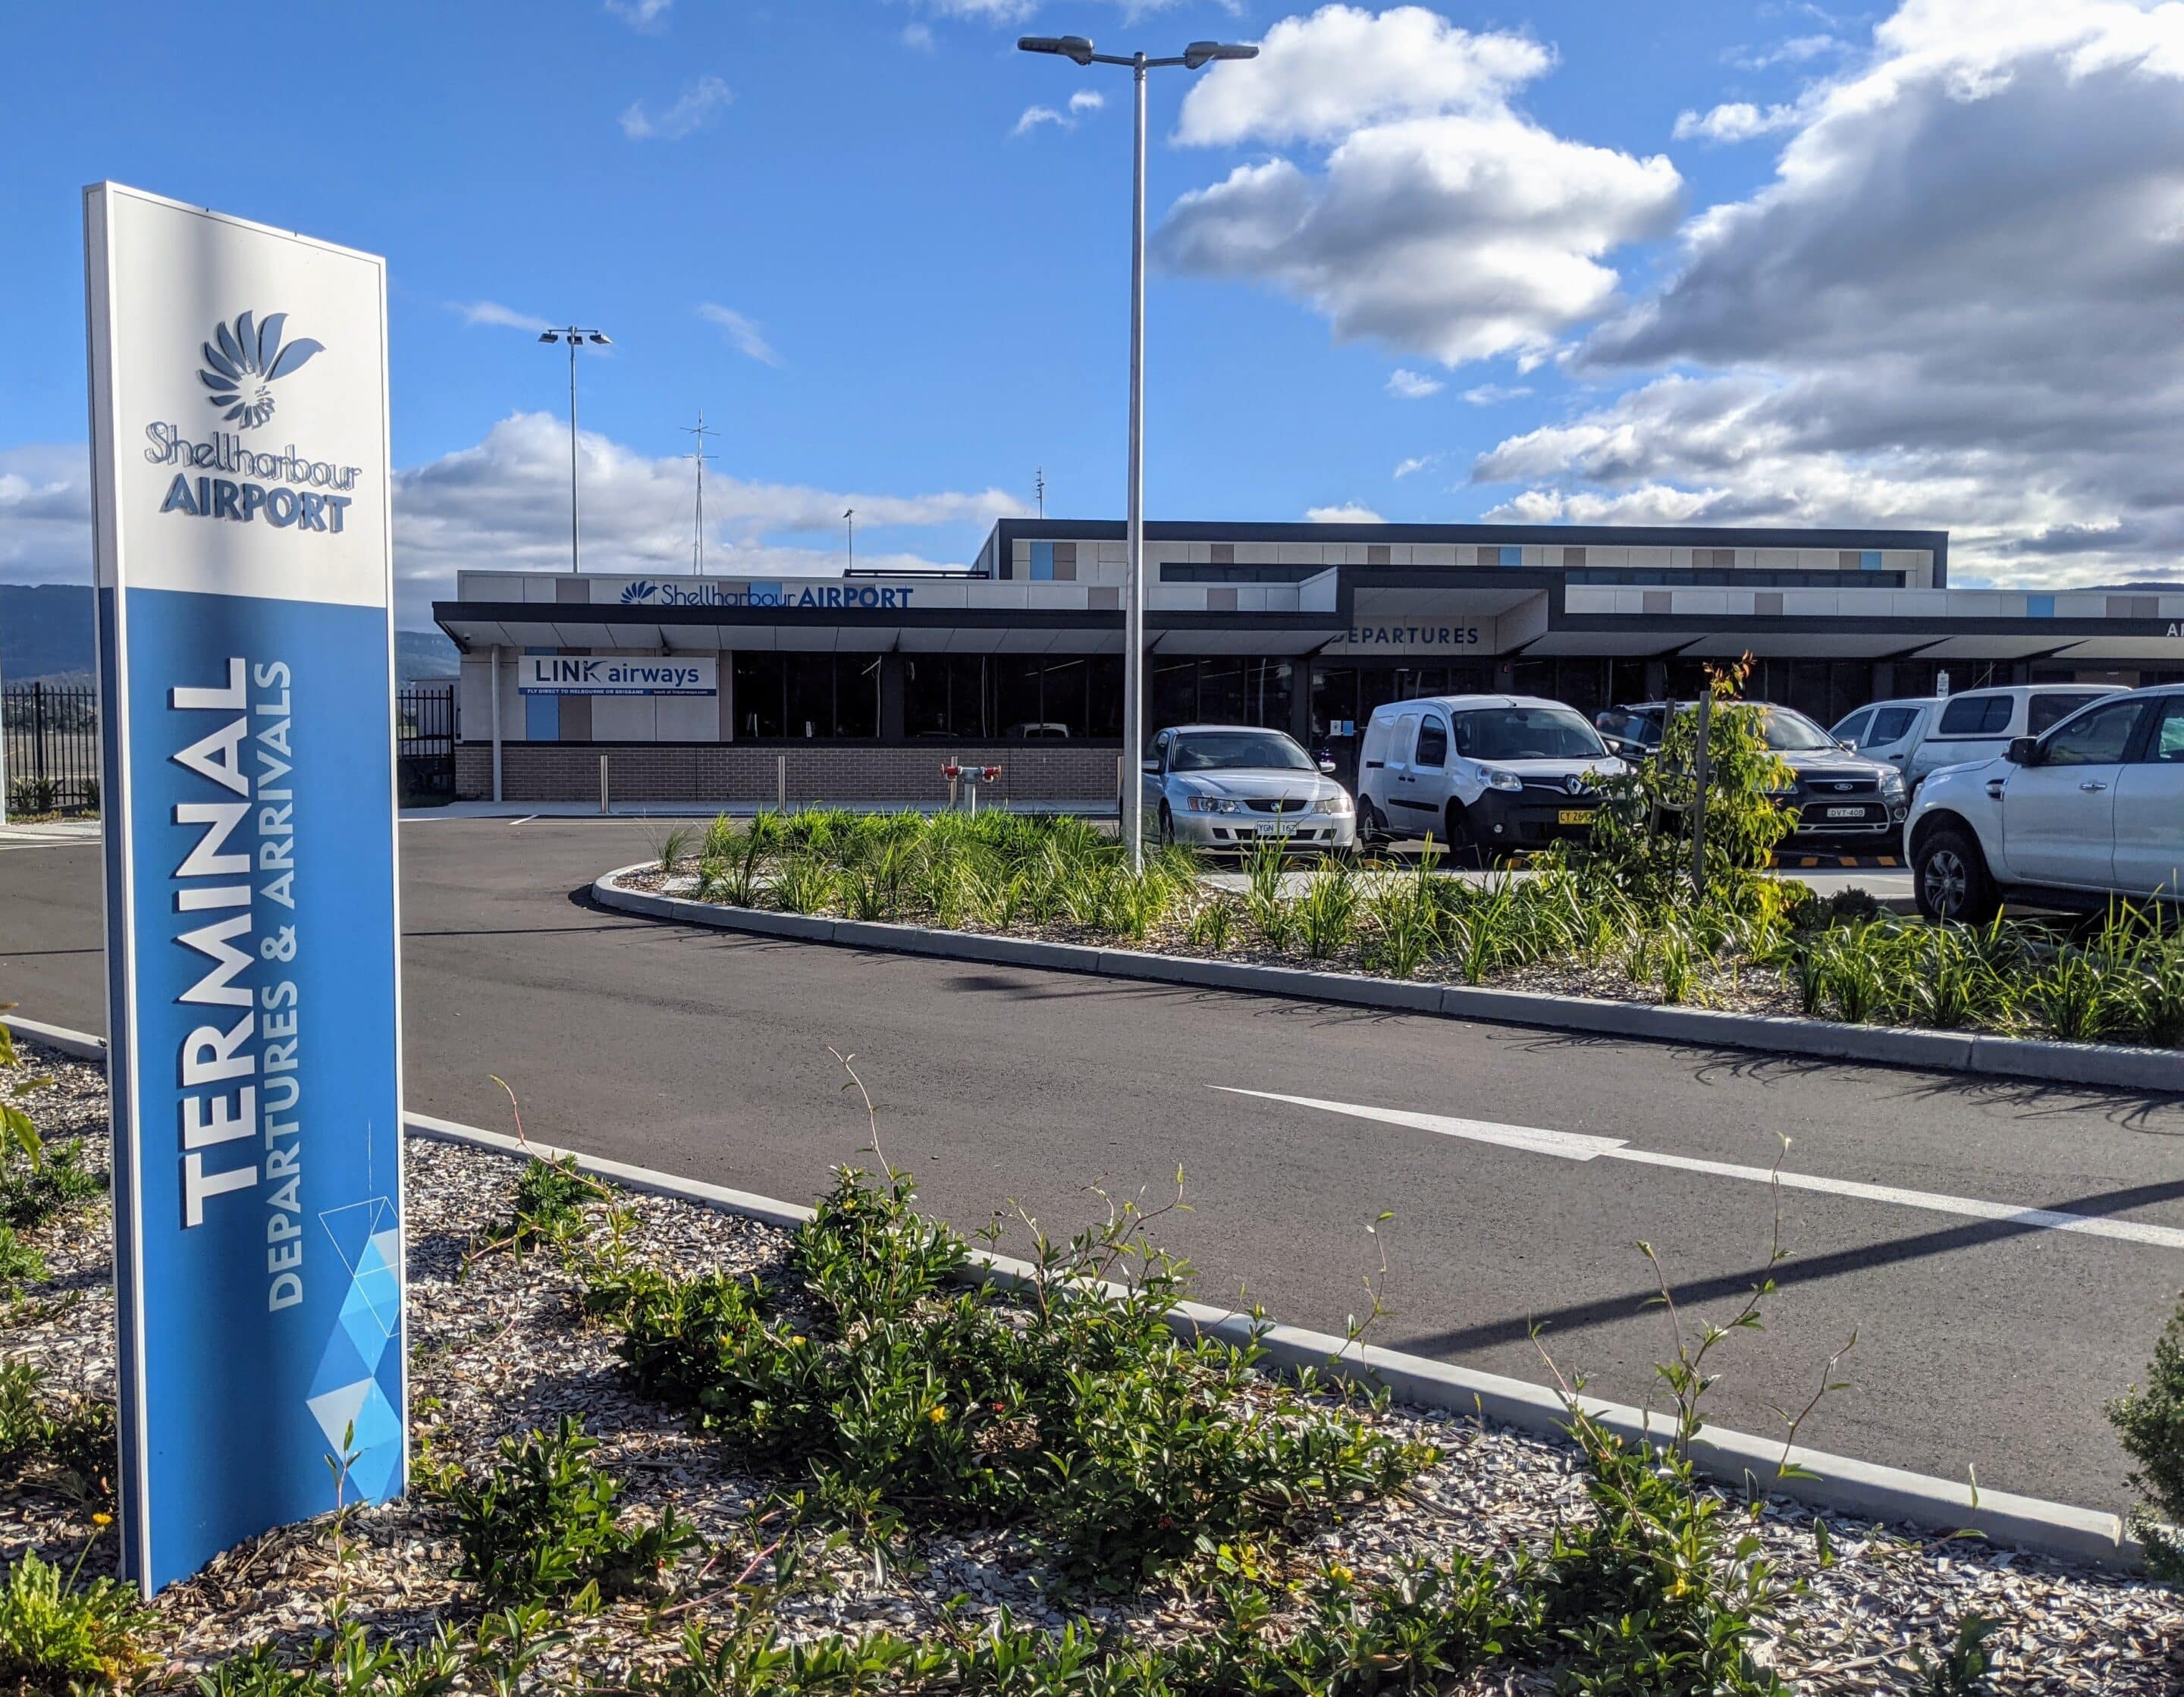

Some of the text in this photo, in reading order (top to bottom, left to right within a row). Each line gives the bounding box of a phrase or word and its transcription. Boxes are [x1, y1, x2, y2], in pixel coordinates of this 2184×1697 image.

[144, 422, 362, 491] Shellharbour
[159, 472, 352, 533] AIRPORT
[661, 585, 913, 607] Shellharbour AIRPORT
[535, 660, 699, 687] LINK airways
[173, 657, 258, 1228] TERMINAL
[254, 660, 303, 1313] DEPARTURES & ARRIVALS
